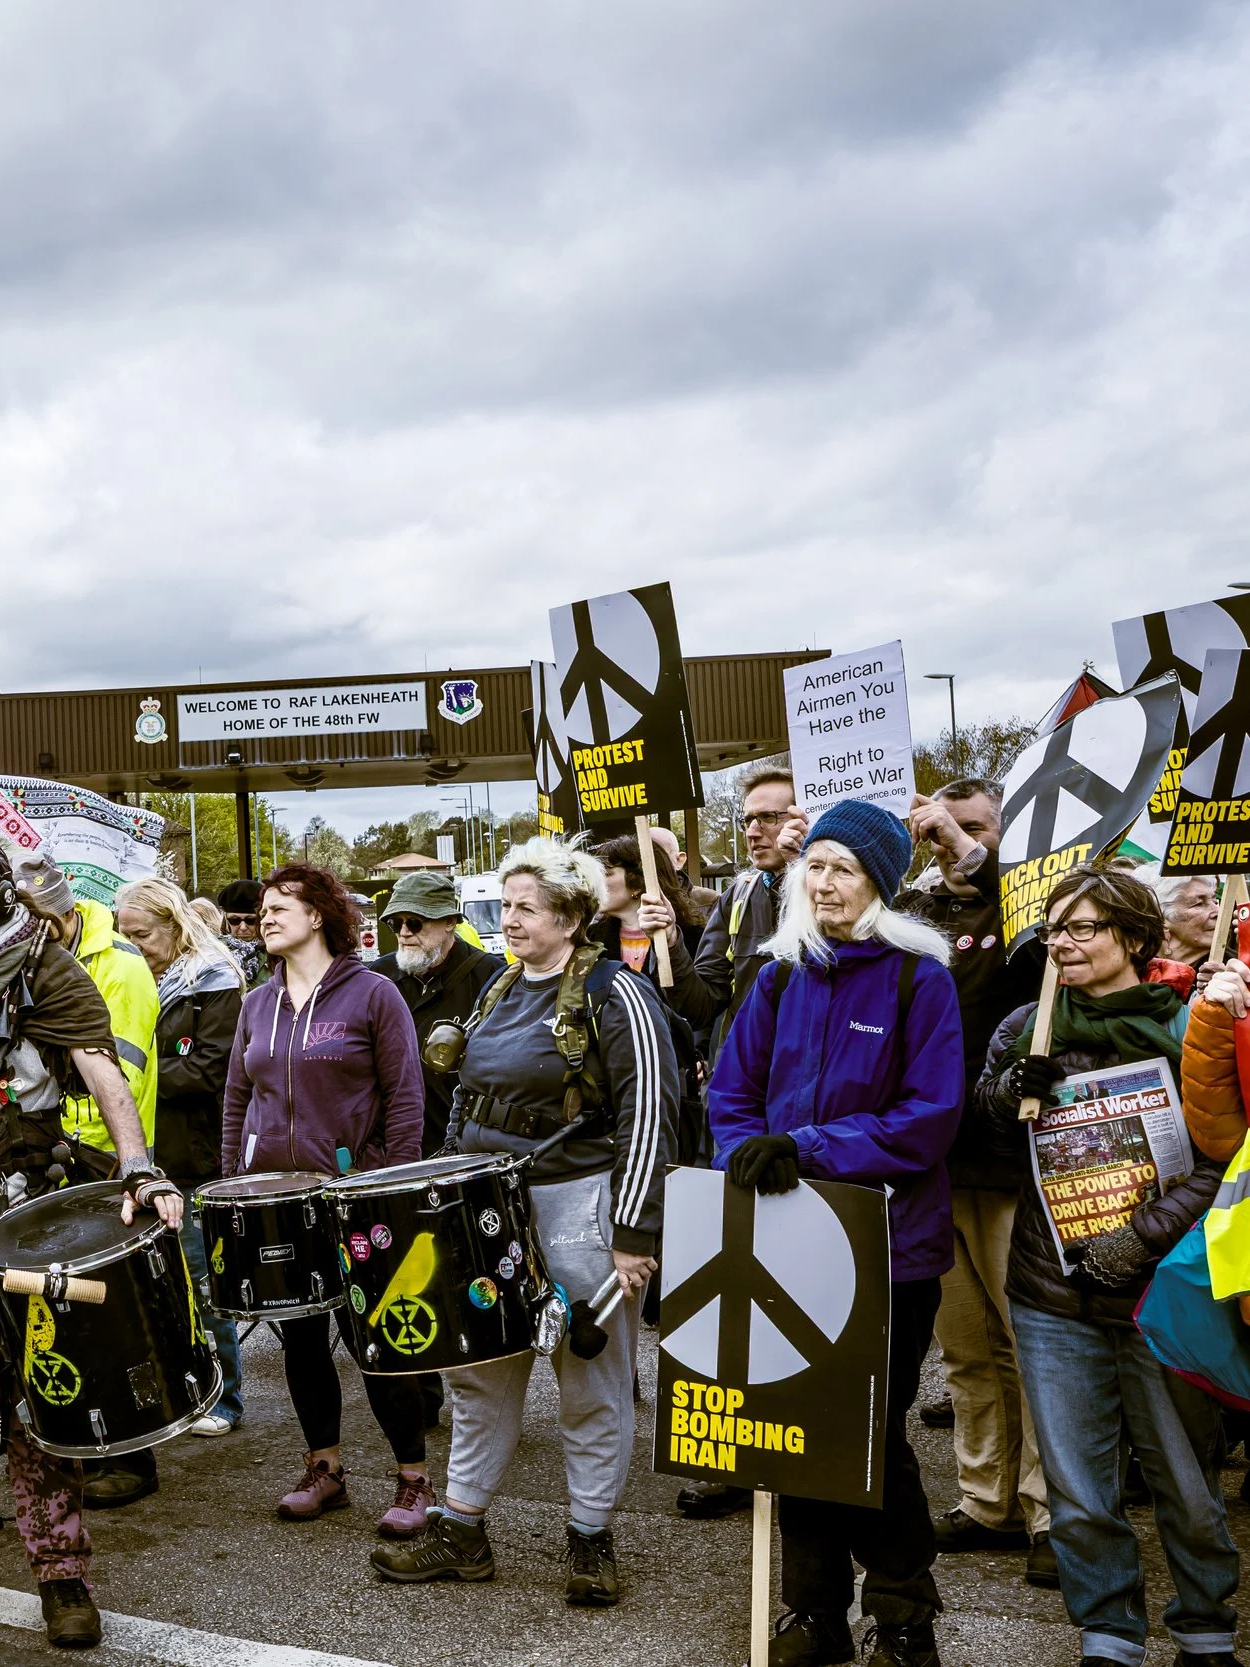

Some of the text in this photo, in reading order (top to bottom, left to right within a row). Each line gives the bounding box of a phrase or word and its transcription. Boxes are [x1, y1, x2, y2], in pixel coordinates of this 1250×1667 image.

[803, 661, 883, 692] American
[185, 690, 419, 714] WELCOME TO RAF LAKENHEATH
[797, 682, 894, 716] Airmen You
[223, 712, 380, 732] HOME OF THE 48th FW
[809, 707, 886, 736] Have the
[572, 740, 644, 771] PROTEST
[819, 748, 884, 773] Right to
[578, 768, 608, 792] AND
[804, 767, 905, 800] Refuse War
[580, 783, 648, 812] SURVIVE
[1176, 800, 1250, 822] PROTES
[1170, 823, 1214, 844] AND
[1000, 857, 1043, 895] KICK
[1042, 842, 1093, 876] OUT
[1167, 842, 1250, 866] SURVIVE
[850, 1020, 884, 1034] Marmot
[1042, 1102, 1103, 1127] Socialist
[1102, 1091, 1166, 1115] Worker
[1106, 1162, 1124, 1171] MARCH
[1044, 1164, 1156, 1200] THE POWER TO
[1050, 1188, 1141, 1220] DRIVE BACK
[1057, 1210, 1133, 1239] THE RIGHT
[550, 1232, 587, 1247] saltrock
[672, 1380, 745, 1416] STOP
[671, 1408, 805, 1454] BOMBING
[670, 1435, 737, 1473] IRAN
